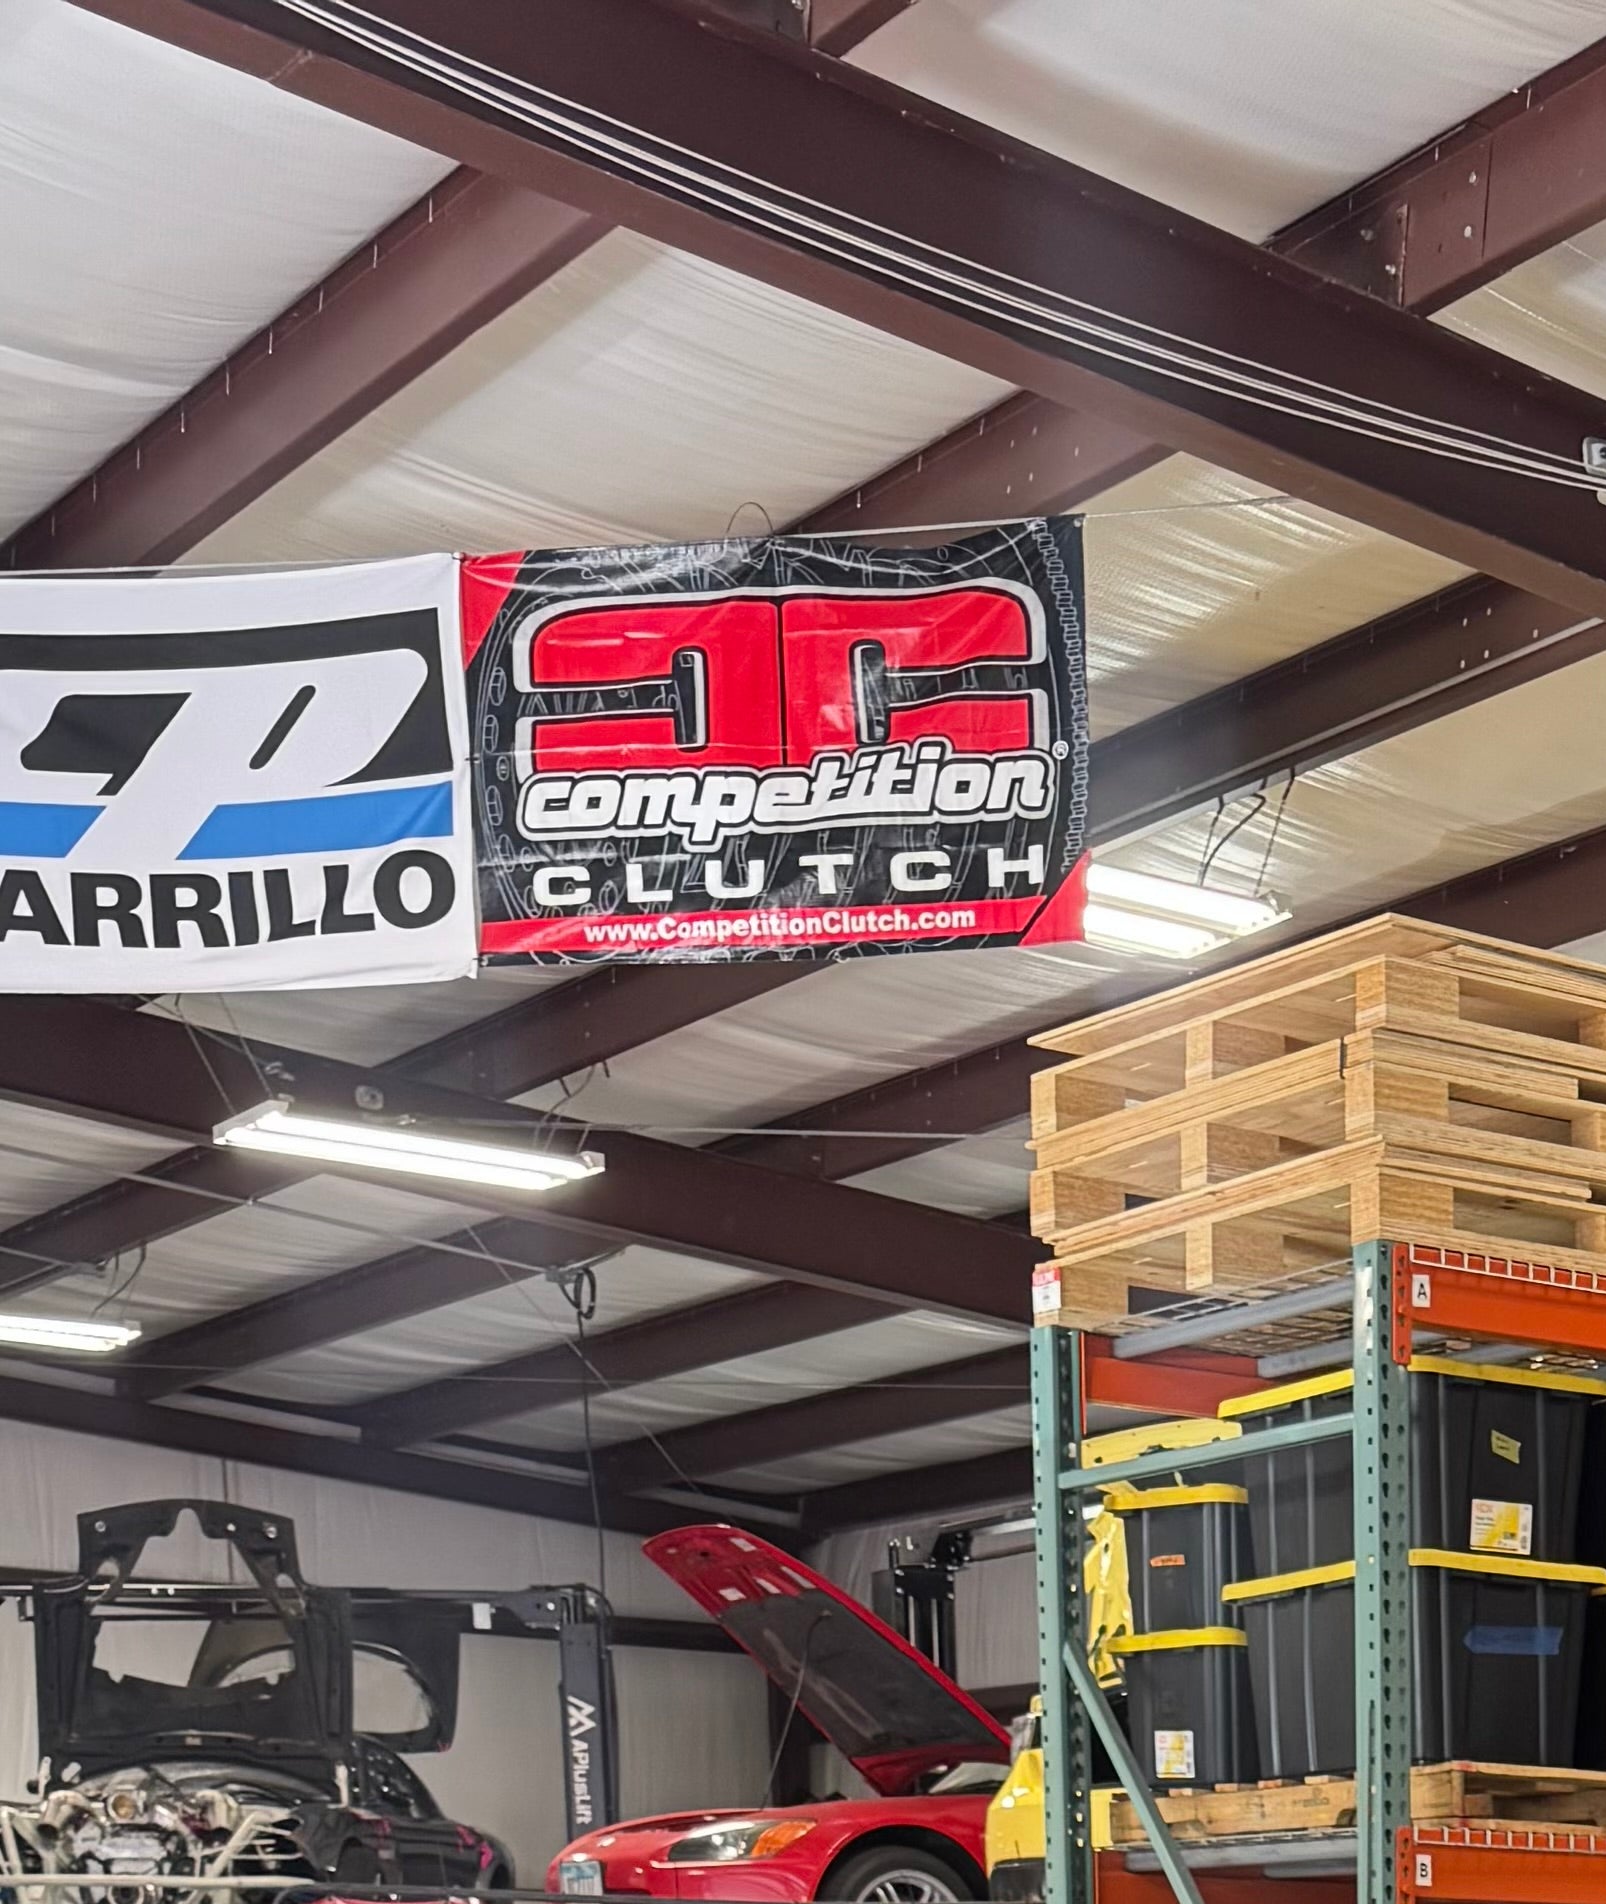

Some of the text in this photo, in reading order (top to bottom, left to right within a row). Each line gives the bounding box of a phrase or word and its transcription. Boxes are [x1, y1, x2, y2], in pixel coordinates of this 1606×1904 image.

[519, 744, 1052, 848] competition
[534, 843, 1045, 908] CLUTCH
[583, 905, 977, 945] www.CompetitionClutch.com
[1416, 1277, 1428, 1300] A
[1419, 1862, 1429, 1880] B
